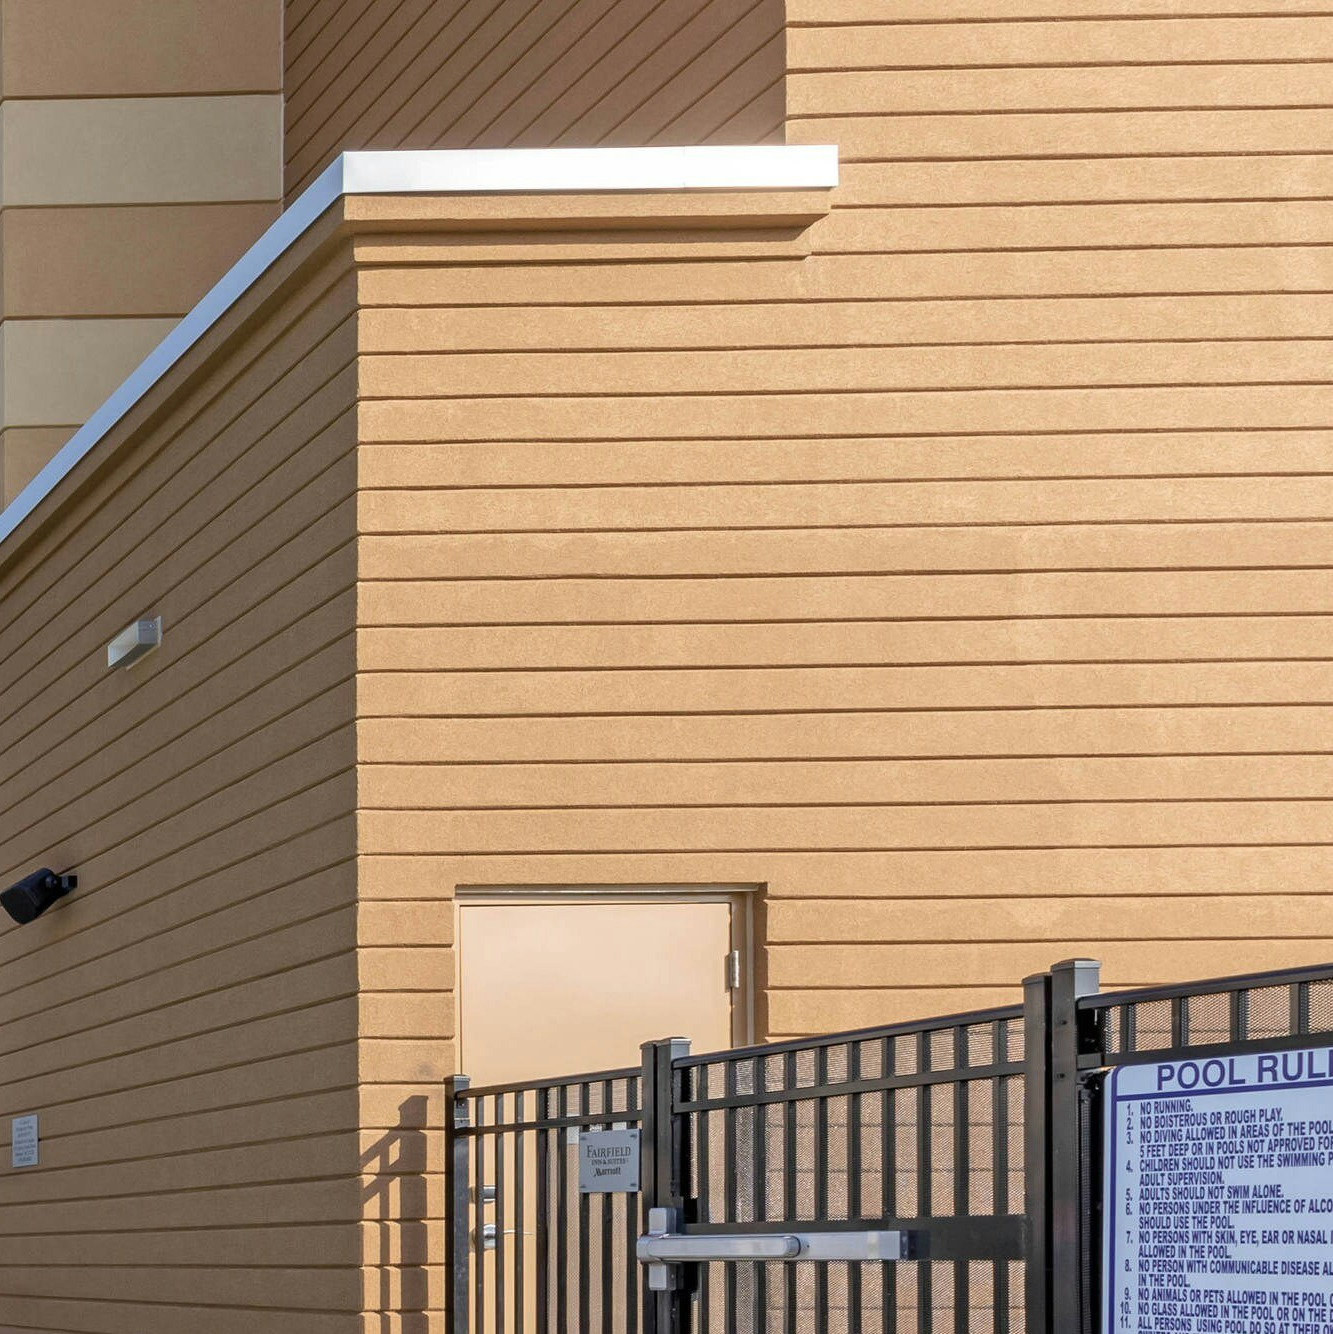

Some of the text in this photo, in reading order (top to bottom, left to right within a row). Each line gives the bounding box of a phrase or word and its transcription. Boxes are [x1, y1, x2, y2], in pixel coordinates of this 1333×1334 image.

[1157, 1050, 1333, 1090] POOL RUL
[1127, 1099, 1193, 1116] 1. NO RUNNING.
[1127, 1108, 1283, 1130] 2. NO BOISTEROUS OR ROUGH PLAY.
[1126, 1132, 1133, 1144] 3.
[1141, 1130, 1151, 1144] NO
[1155, 1129, 1182, 1143] DIVING
[1185, 1126, 1225, 1141] ALLOWED
[1228, 1126, 1237, 1139] IN
[1240, 1124, 1269, 1138] AREAS
[1273, 1123, 1284, 1137] OF
[1288, 1122, 1306, 1136] THE
[587, 1145, 631, 1158] FAIRFIELD
[1126, 1160, 1133, 1172] 4.
[1140, 1158, 1179, 1172] CHILDREN
[1182, 1157, 1215, 1171] SHOULD
[1218, 1156, 1235, 1170] NOT
[1238, 1155, 1254, 1169] USE
[1257, 1154, 1274, 1168] THE
[1277, 1152, 1325, 1167] SWIMMING
[593, 1166, 621, 1177] Marriott
[1140, 1171, 1224, 1187] ADULT SUPERVISION.
[1126, 1185, 1283, 1201] 5. ADULTS SHOULD NOT SWIM ALONE.
[1126, 1203, 1132, 1215] 6.
[1139, 1202, 1150, 1215] NO
[1153, 1201, 1189, 1215] PERSONS
[1192, 1201, 1220, 1214] UNDER
[1223, 1201, 1239, 1214] THE
[1242, 1200, 1291, 1213] INFLUENCE
[1294, 1199, 1305, 1213] OF
[1139, 1216, 1235, 1229] SHOULD USE THE POOL.
[1126, 1232, 1133, 1244] 7.
[1139, 1231, 1150, 1243] NO
[1153, 1231, 1189, 1243] PERSONS
[1192, 1231, 1212, 1244] WITH
[1215, 1231, 1237, 1246] SKIN,
[1241, 1230, 1259, 1246] EYE,
[1262, 1230, 1278, 1244] EAR
[1282, 1230, 1294, 1244] OR
[1297, 1230, 1327, 1244] NASAL
[1139, 1246, 1232, 1259] ALLOWED IN THE POOL.
[1125, 1260, 1132, 1271] 8.
[1139, 1260, 1149, 1272] NO
[1153, 1260, 1184, 1273] PERSON
[1187, 1261, 1207, 1273] WITH
[1210, 1261, 1278, 1274] COMMUNICABLE
[1281, 1261, 1319, 1275] DISEASE
[1139, 1275, 1190, 1288] IN THE POOL.
[1125, 1289, 1131, 1300] 9.
[1138, 1288, 1149, 1301] NO
[1152, 1289, 1187, 1302] ANIMALS
[1190, 1289, 1201, 1302] OR
[1204, 1290, 1224, 1303] PETS
[1227, 1290, 1266, 1304] ALLOWED
[1269, 1291, 1278, 1305] IN
[1281, 1292, 1299, 1305] THE
[1302, 1292, 1326, 1306] POOL
